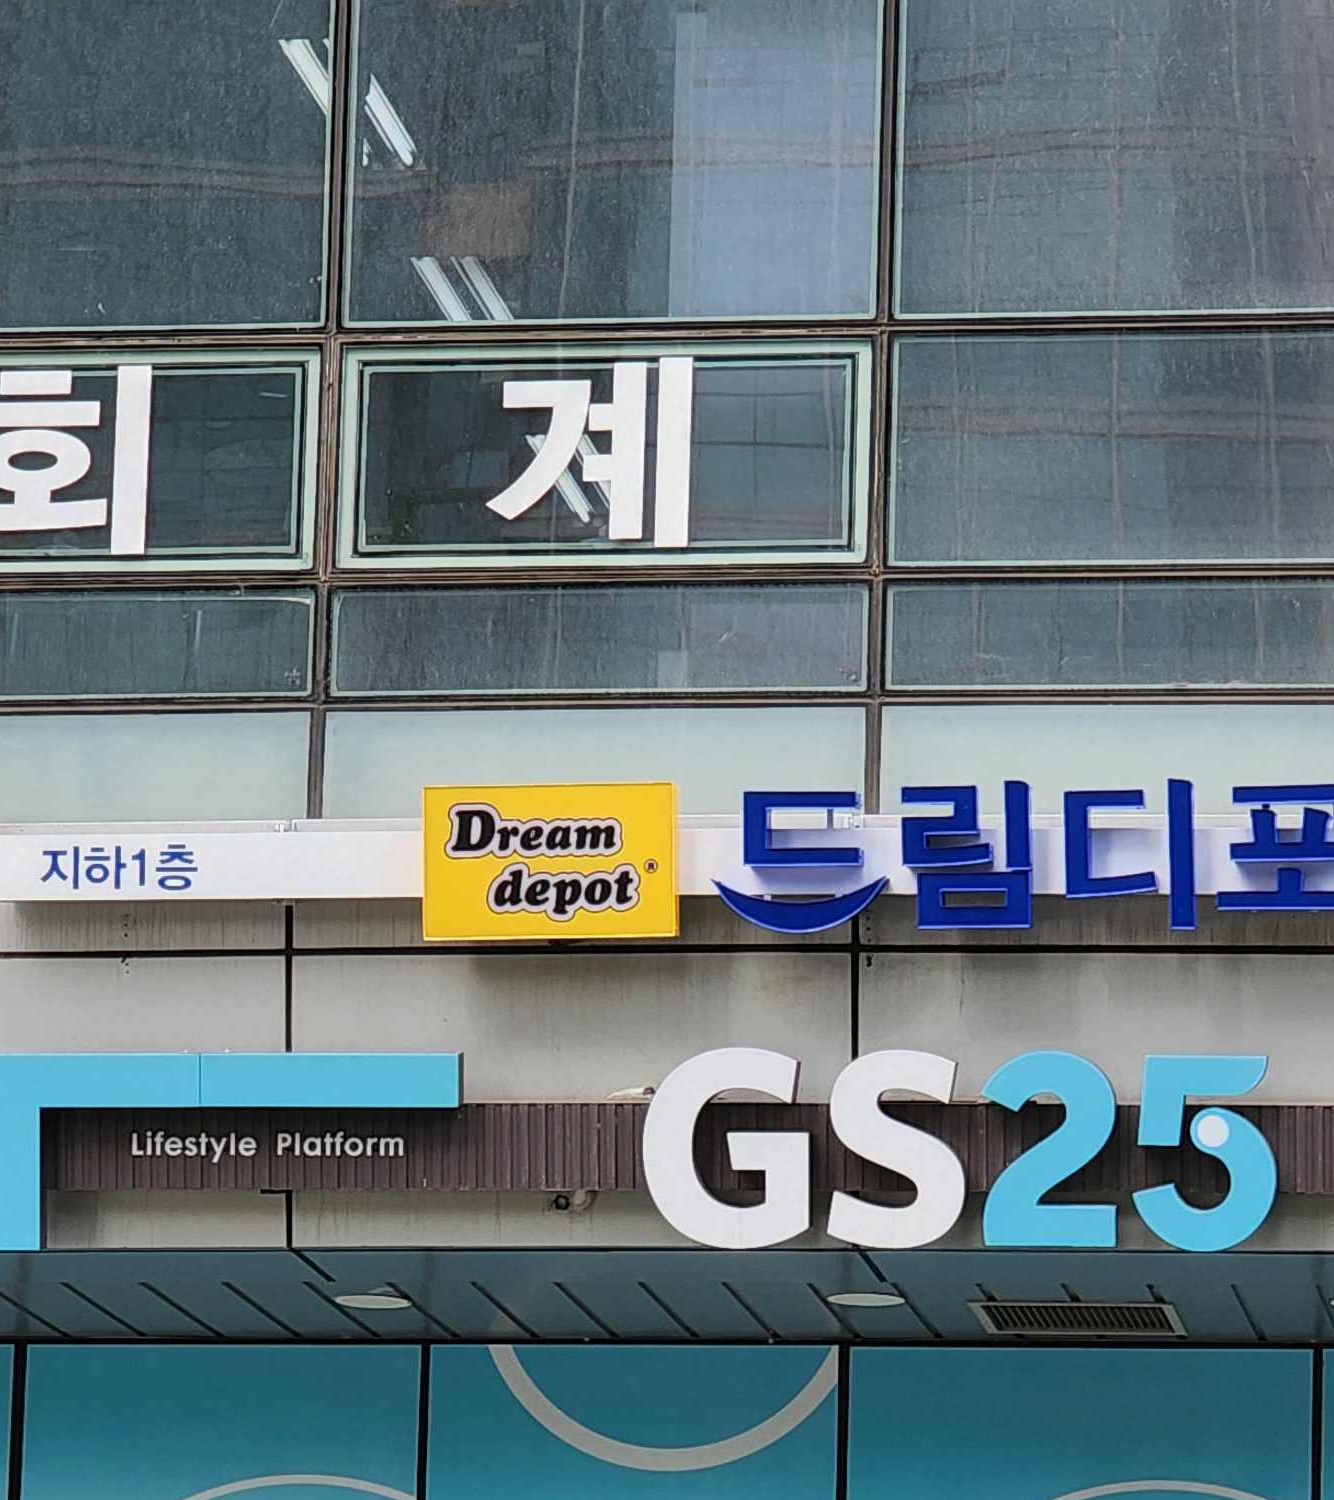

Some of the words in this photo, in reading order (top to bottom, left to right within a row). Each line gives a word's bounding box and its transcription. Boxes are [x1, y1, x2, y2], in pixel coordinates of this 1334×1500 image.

[450, 801, 618, 855] Dream
[40, 844, 199, 891] 지하1층
[492, 864, 635, 917] depot
[130, 1131, 259, 1163] Lifestyle
[276, 1132, 405, 1159] Platform
[643, 1047, 1278, 1252] GS25
